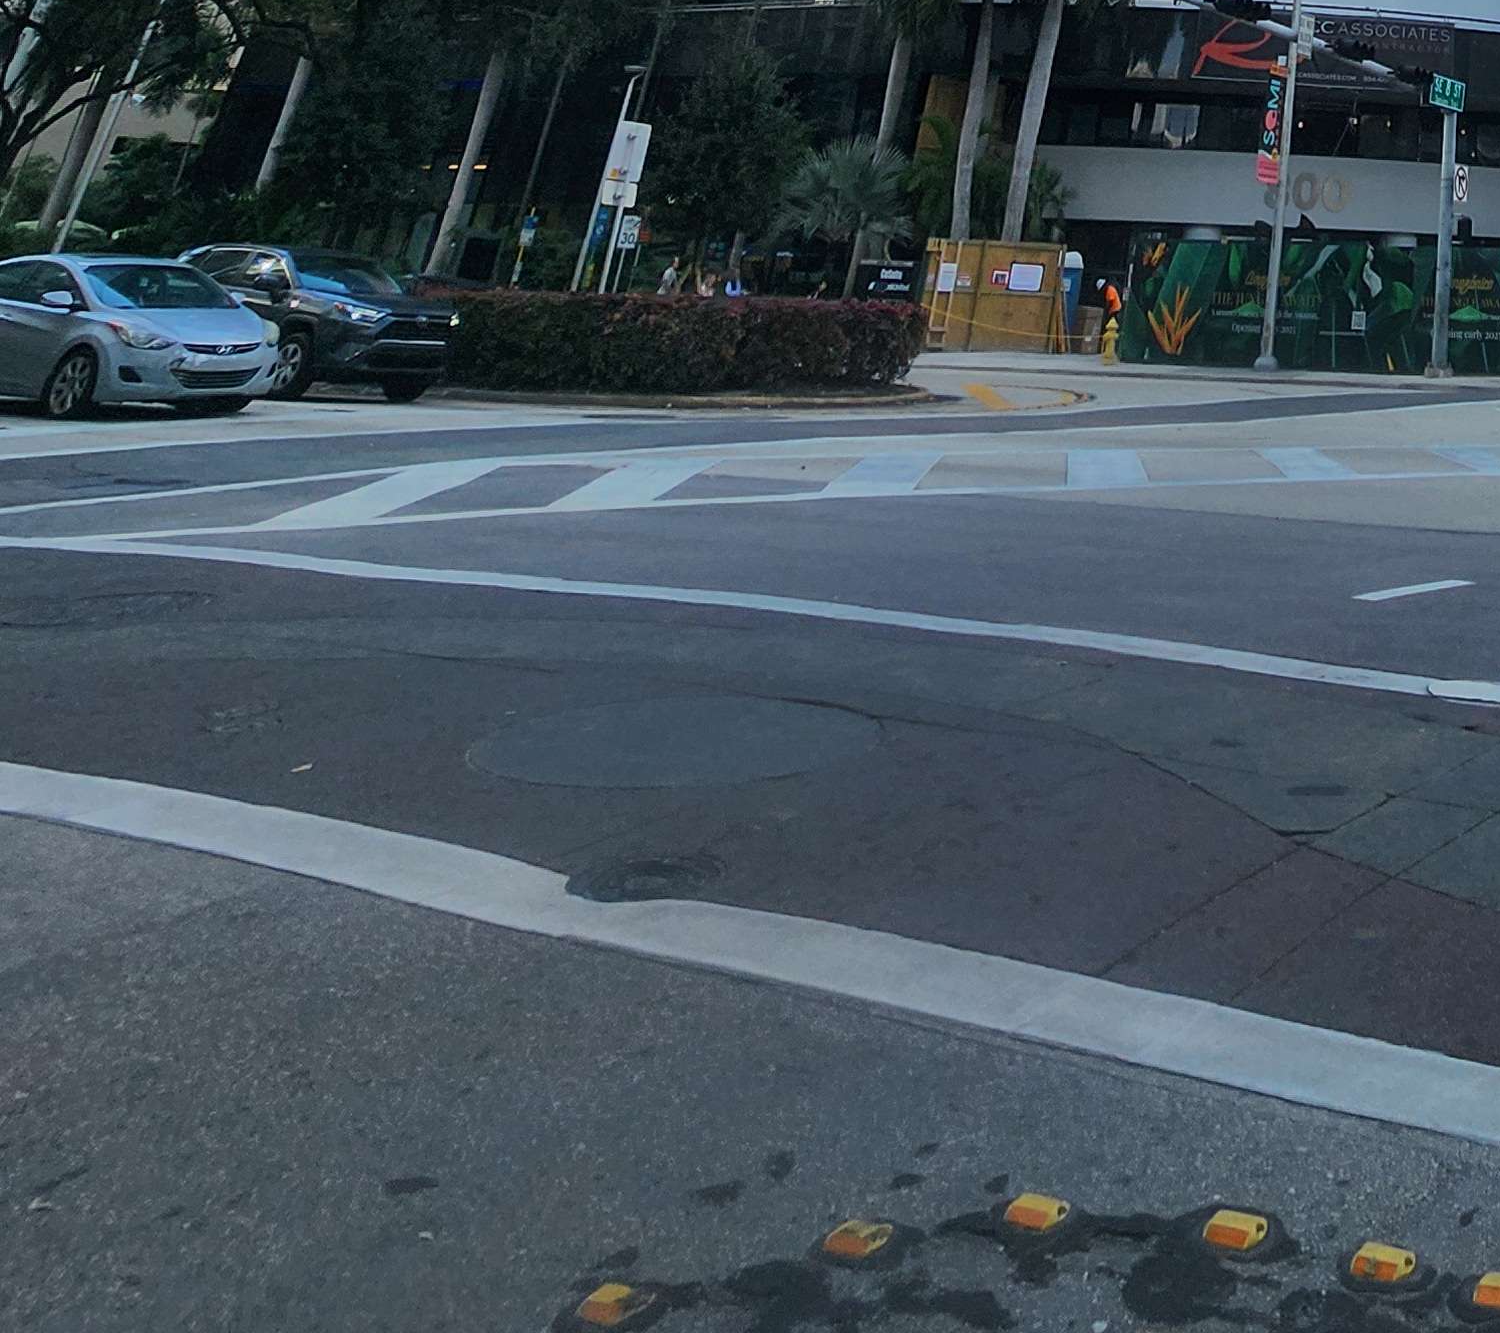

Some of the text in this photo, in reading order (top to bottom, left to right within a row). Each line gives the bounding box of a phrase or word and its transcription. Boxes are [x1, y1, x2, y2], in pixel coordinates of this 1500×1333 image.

[1337, 21, 1451, 42] ASSOCIATES
[1434, 77, 1444, 94] SE
[1445, 80, 1451, 97] 8
[620, 232, 636, 244] 30
